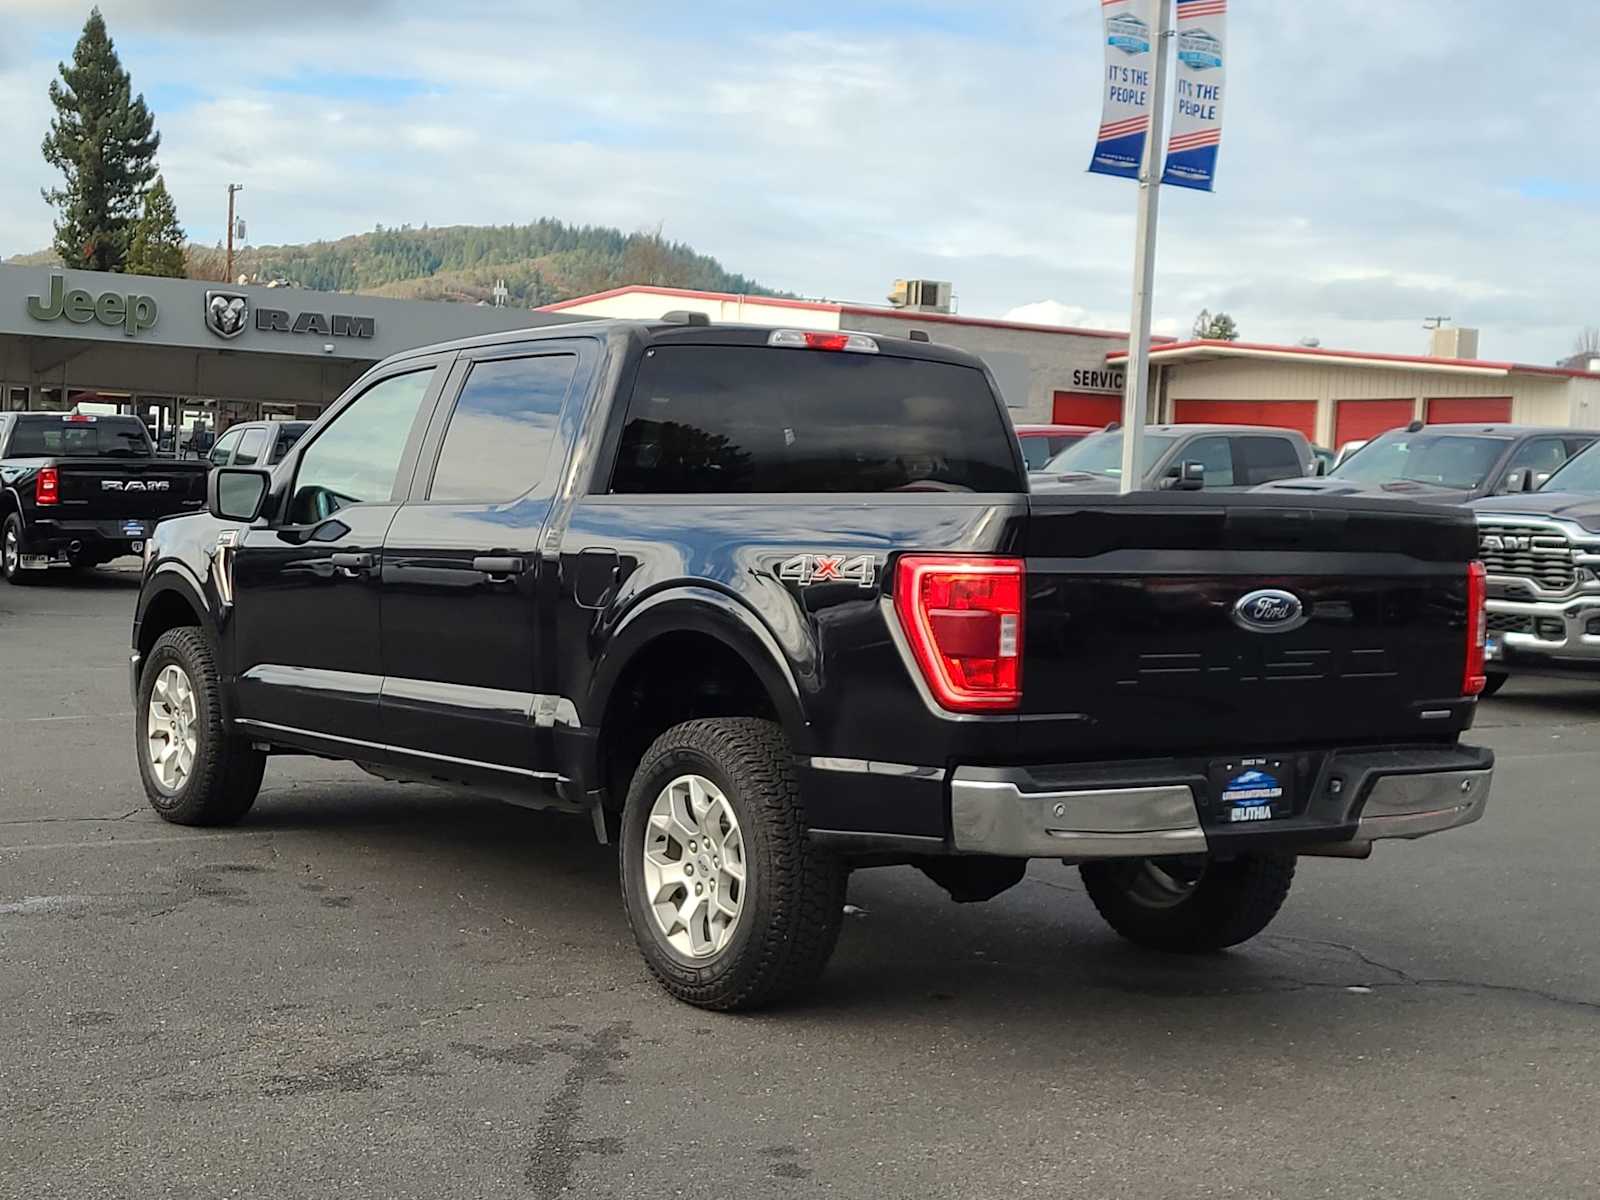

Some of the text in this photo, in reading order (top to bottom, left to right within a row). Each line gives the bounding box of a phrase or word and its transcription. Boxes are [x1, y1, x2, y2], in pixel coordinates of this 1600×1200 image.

[1109, 65, 1149, 86] IT'S THE
[1110, 86, 1147, 106] PEOPLE
[1196, 84, 1220, 101] THE
[25, 275, 158, 336] Jeep
[255, 308, 375, 338] RAM
[1073, 369, 1123, 388] SERVIC
[101, 480, 170, 491] RAM
[1480, 535, 1530, 551] AM
[780, 554, 876, 588] 4X4
[1253, 597, 1290, 619] Ford
